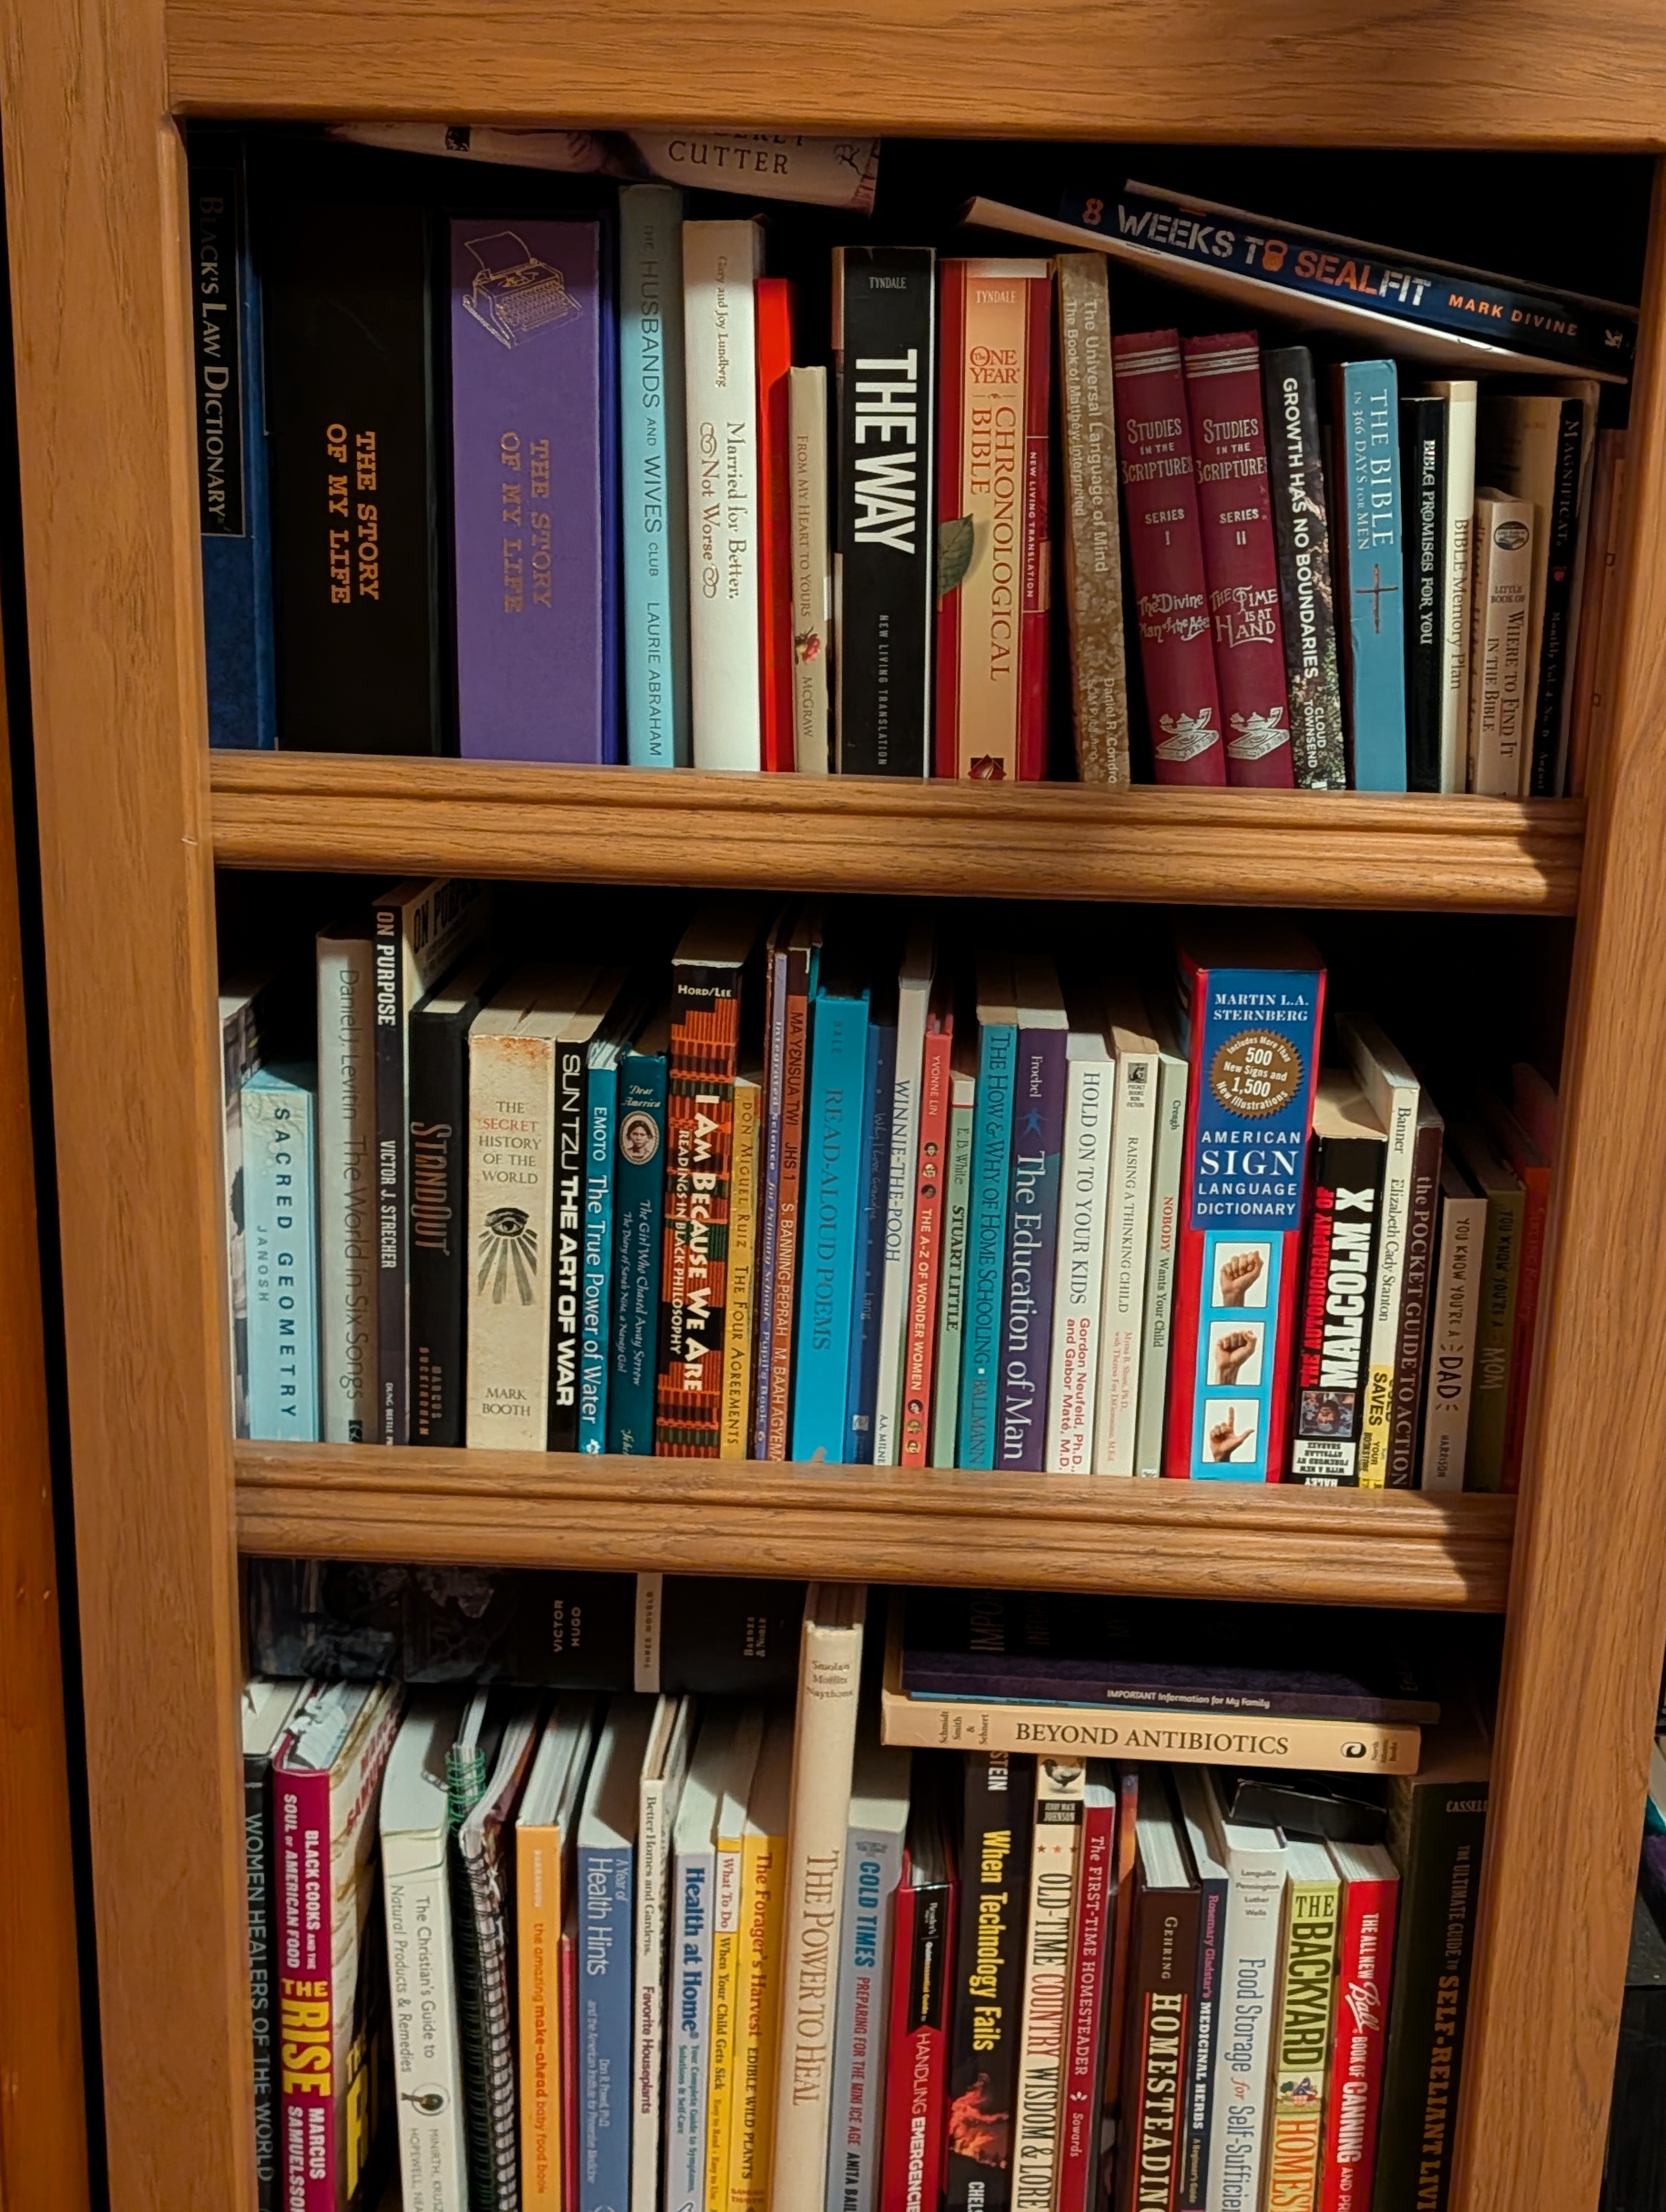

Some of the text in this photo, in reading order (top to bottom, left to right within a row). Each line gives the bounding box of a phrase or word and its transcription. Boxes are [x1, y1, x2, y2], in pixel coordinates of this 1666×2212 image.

[668, 140, 789, 175] CUTTER
[1082, 198, 1578, 337] 8 WEEKS SEALFIT MARK DIVINE
[201, 302, 230, 518] LAW DICTIONARY
[640, 261, 663, 576] HUSBANDS WIVES CLUB
[854, 349, 918, 554] THE WAY
[1353, 410, 1369, 550] 366 DAYS MEN
[1370, 389, 1394, 547] THE BIBLE
[326, 423, 351, 604] OF MY LIFE
[356, 431, 379, 600] THE STORY
[701, 459, 720, 561] Not Worse
[725, 422, 748, 600] Married for Better,
[798, 505, 812, 618] HEART TO YOURS
[970, 407, 1017, 682] CHRONOLOGICAL BIBLE
[1283, 377, 1319, 679] GROWTH HAS NO BOUNDARIES
[1447, 518, 1469, 690] BIBLE Memory Plan
[647, 602, 663, 756] LAURIE ABRAHAM
[877, 614, 889, 765] NEW LIVING TRANSLATION
[1303, 699, 1318, 768] TOWNSEND
[1314, 707, 1327, 748] CLOUD
[375, 912, 396, 1026] ON PURPOSE
[1213, 1009, 1308, 1021] STERNBERG
[479, 1136, 542, 1150] HISTORY
[483, 1118, 539, 1132] SECRET
[1201, 1131, 1301, 1144] AMERICAN
[1231, 1076, 1271, 1097] 1,500
[380, 1141, 397, 1269] VICTOR STRECHER
[482, 1171, 539, 1184] WORLD
[556, 1054, 581, 1406] SUN TZU THE ART OF WAR
[885, 1080, 911, 1262] WINNIE-THE-POOH
[1069, 1072, 1100, 1304] HOLD ON TO YOUR KIDS
[1197, 1203, 1296, 1216] DICTIONARY
[1199, 1183, 1297, 1196] LANGUAGE
[1200, 1150, 1299, 1176] SIGN
[274, 1108, 297, 1418] SACRED GEOMETRY
[581, 1107, 608, 1424] EMOTO The True Power of Water
[670, 1130, 690, 1355] READINGS IN BLACK PHILOSOPHY
[683, 1113, 719, 1391] AM BECAUSE WE ARE
[946, 1205, 965, 1332] STUART LITTLE
[1004, 1150, 1046, 1460] The Education of Man
[1152, 1196, 1174, 1348] NOBODY Wants Your Child
[1320, 1188, 1375, 1388] MALCOLM X
[1378, 1179, 1405, 1322] Elizabeth Cady Stanton
[485, 1387, 527, 1400] MARK
[727, 1266, 749, 1444] THE FOUR AGREEMENTS
[1368, 1372, 1387, 1426] SAVES
[1392, 1176, 1432, 1486] the POCKET GUIDE TO ACTION
[1437, 1356, 1463, 1399] DAD
[482, 1403, 530, 1417] BOOTH
[1016, 1722, 1290, 1757] BEYOND ANTIBIOTICS
[390, 1885, 413, 2073] Natural Products Remedies
[587, 1857, 613, 1976] Health Hints
[792, 1851, 840, 2106] THE POWER TO HEAL
[969, 1830, 1012, 2051] When Technology Fails
[1075, 1866, 1103, 2076] FIRST-TIME HOMESTEADER
[248, 1910, 273, 2182] HEALERS OF THE WORLD
[281, 1999, 332, 2097] RISE
[639, 1986, 655, 2114] Favorite Houseplants
[714, 1938, 729, 2091] When Your Child Gets Sick
[1017, 1873, 1073, 2210] OLD-TIME COUNTRY WISDOM LORE
[1225, 1959, 1266, 2072] Food Storage
[1283, 1922, 1334, 2065] BACKYARD
[1192, 2002, 1213, 2130] MEDICINAL HERBS
[1336, 2081, 1368, 2164] CANNING
